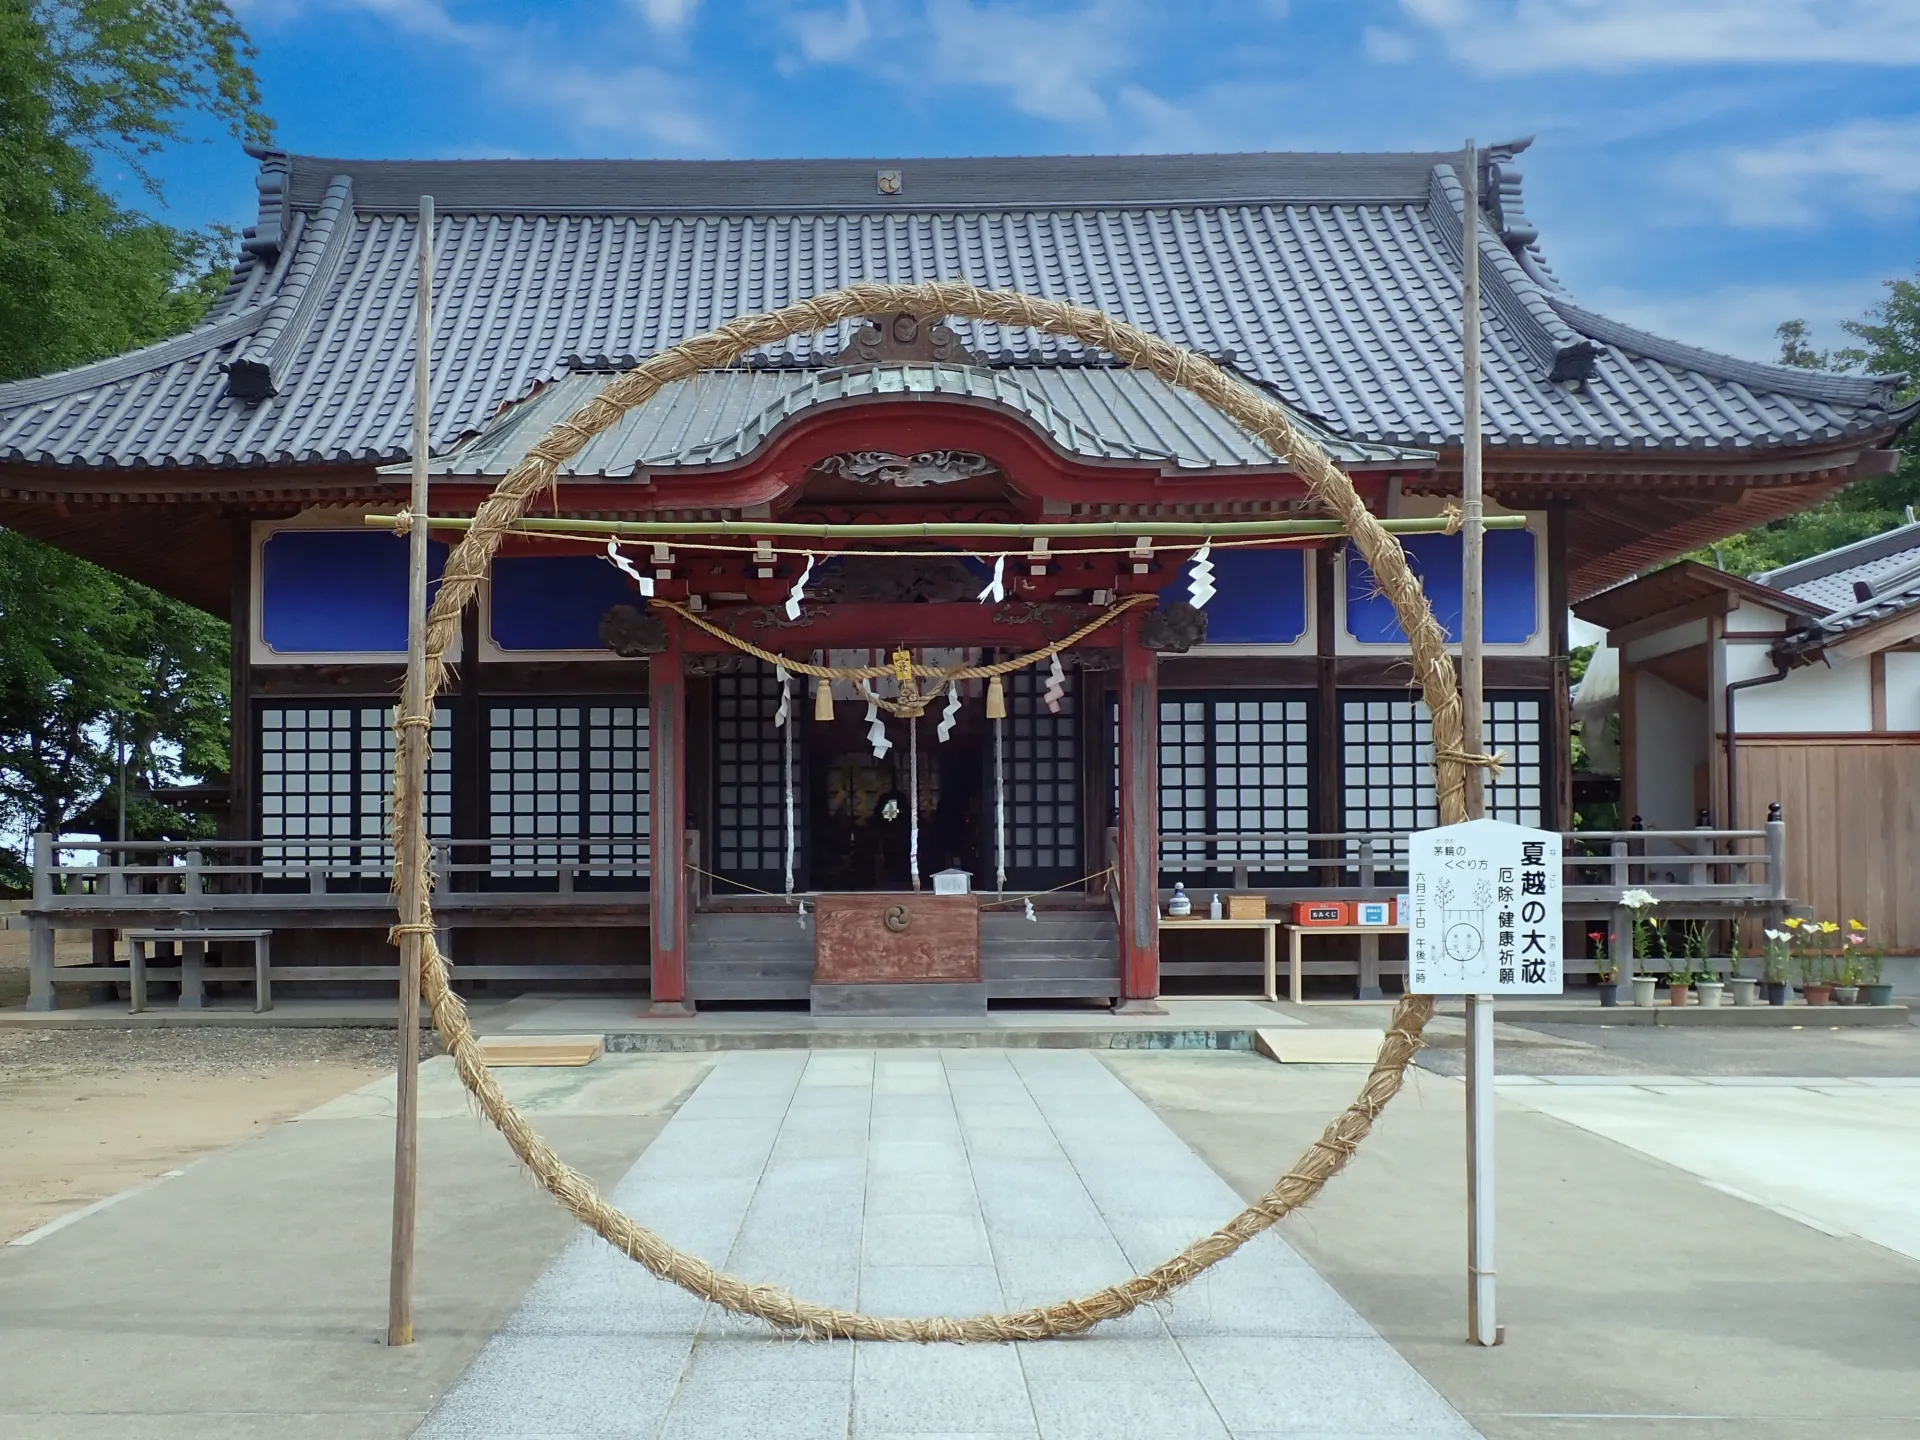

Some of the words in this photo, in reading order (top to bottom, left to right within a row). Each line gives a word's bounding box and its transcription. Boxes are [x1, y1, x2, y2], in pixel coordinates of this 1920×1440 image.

[1433, 845, 1467, 857] 茅輪の
[1445, 859, 1489, 870] くぐり方
[1416, 872, 1426, 928] 六月三十日
[1498, 867, 1515, 984] 厄除・健康祈願
[1520, 841, 1546, 984] 夏越の大祓
[1416, 938, 1426, 984] 午後二時
